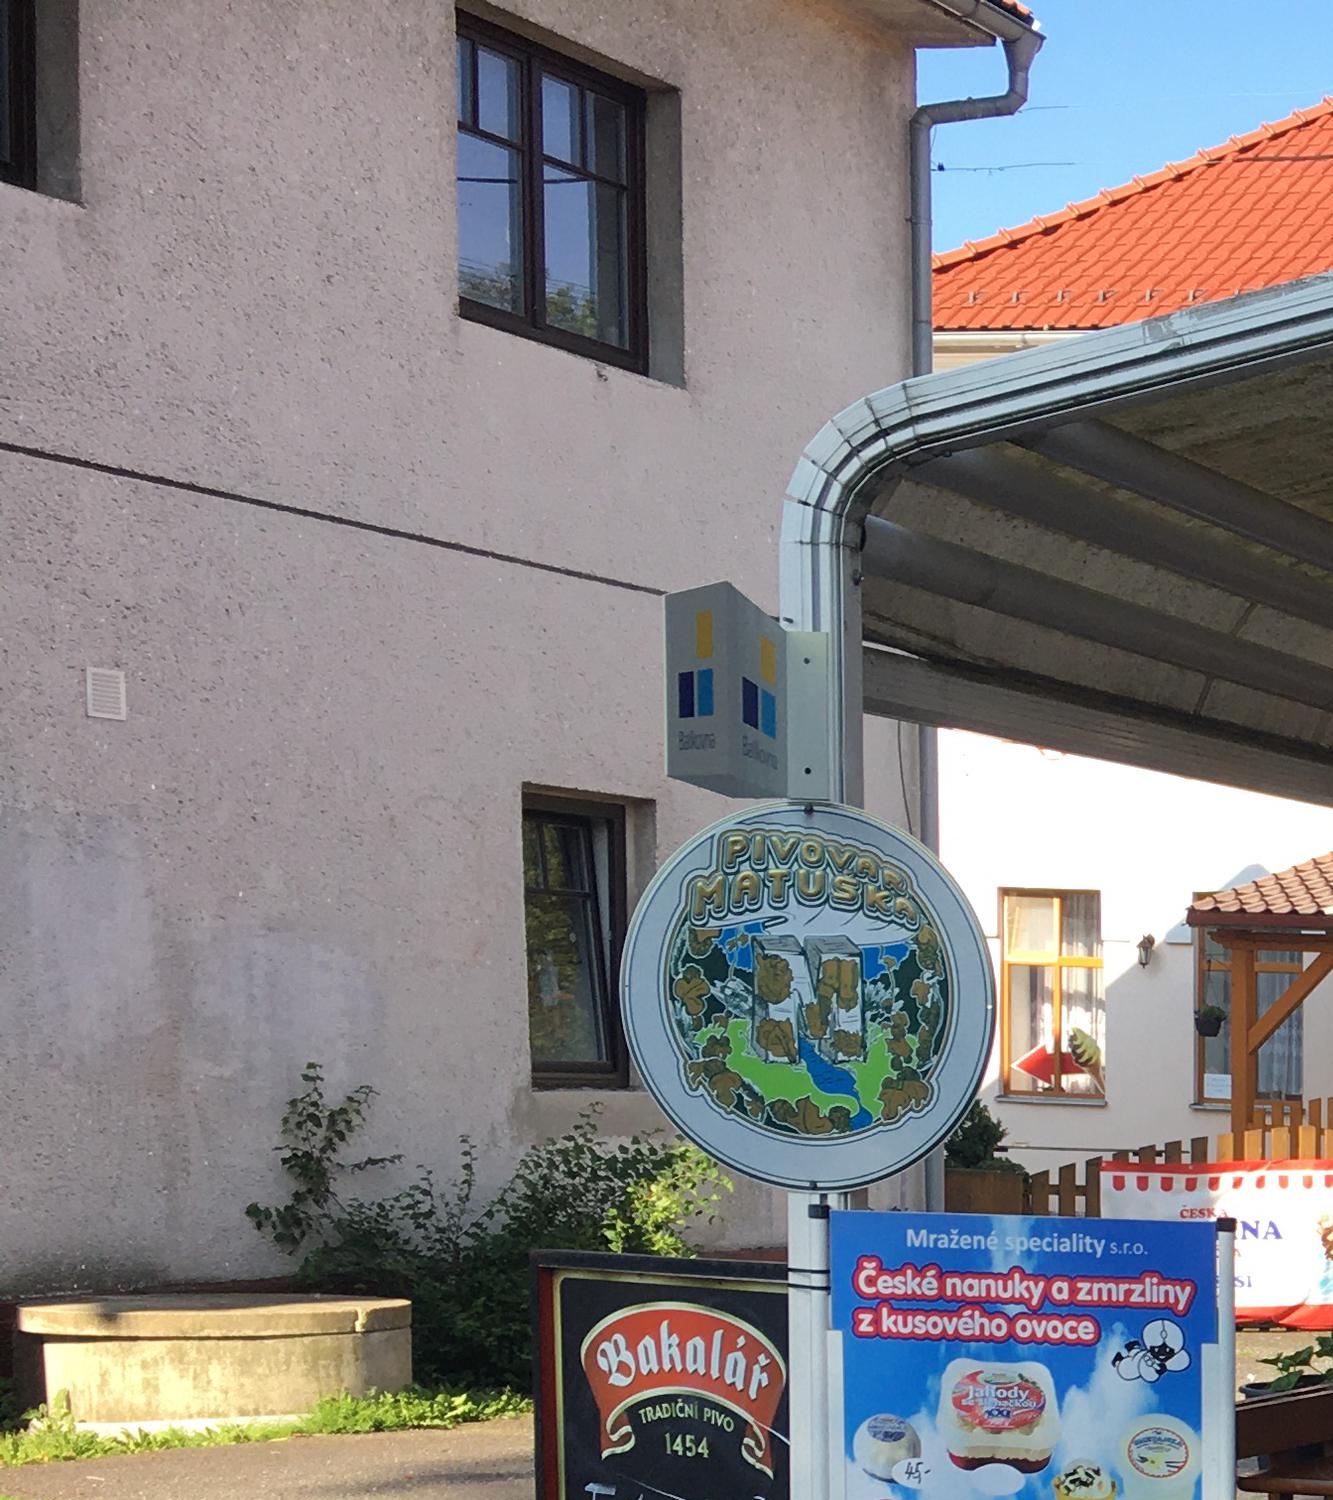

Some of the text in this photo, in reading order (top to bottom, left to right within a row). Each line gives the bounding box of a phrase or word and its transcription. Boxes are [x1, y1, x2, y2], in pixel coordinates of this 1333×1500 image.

[722, 832, 911, 897] PIVOVAR
[691, 866, 921, 927] MATUŠKA
[906, 1228, 1149, 1259] Mražené speciality s.r.o.
[857, 1261, 1192, 1311] České nanuky a zmrzliny
[857, 1307, 1096, 1341] z kusového ovoce
[596, 1319, 771, 1400] Bakalář
[638, 1398, 735, 1433] TRADIČNÍ PIVO
[664, 1432, 710, 1459] 1454
